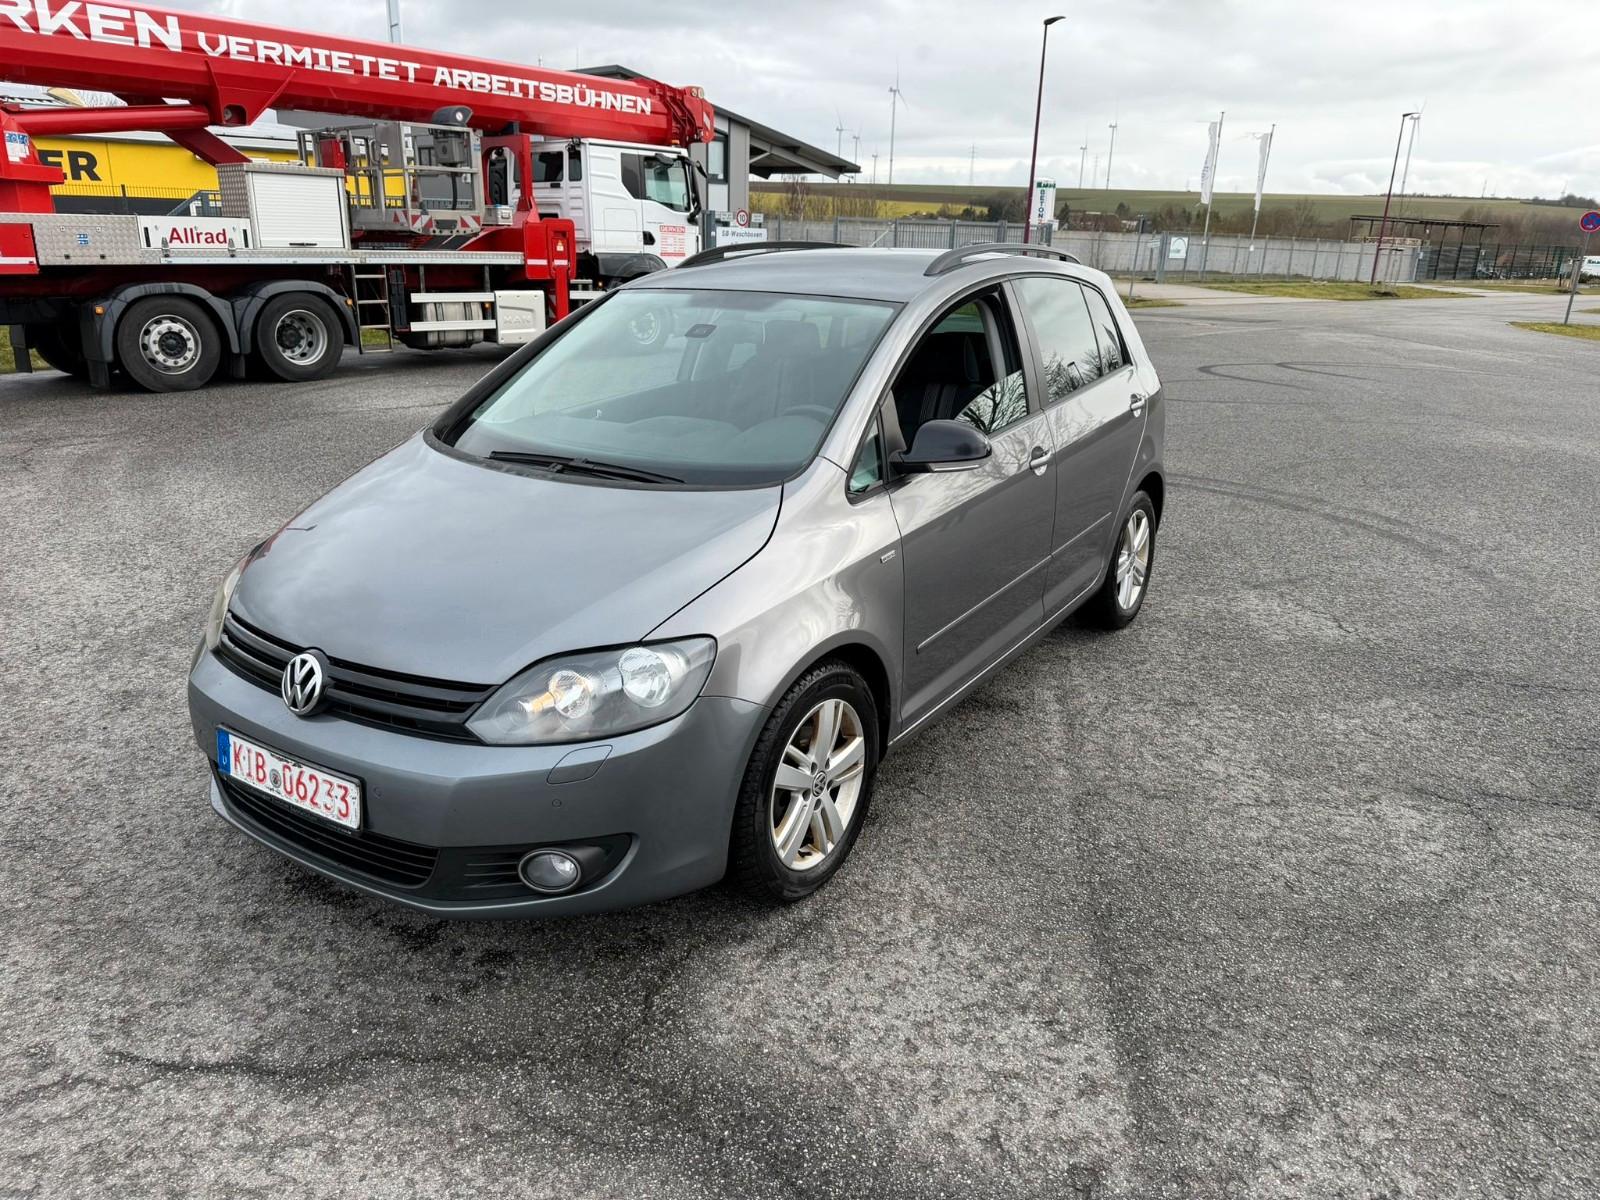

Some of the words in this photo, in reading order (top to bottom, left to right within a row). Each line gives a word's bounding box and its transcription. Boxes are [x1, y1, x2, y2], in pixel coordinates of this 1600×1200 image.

[197, 31, 420, 83] VERMIETET
[433, 66, 651, 116] ARBEITSBÜHNEN
[739, 214, 746, 223] 10
[168, 227, 228, 245] Allrad
[503, 315, 532, 327] MAN
[233, 741, 266, 783] KIB
[282, 764, 350, 818] 06233
